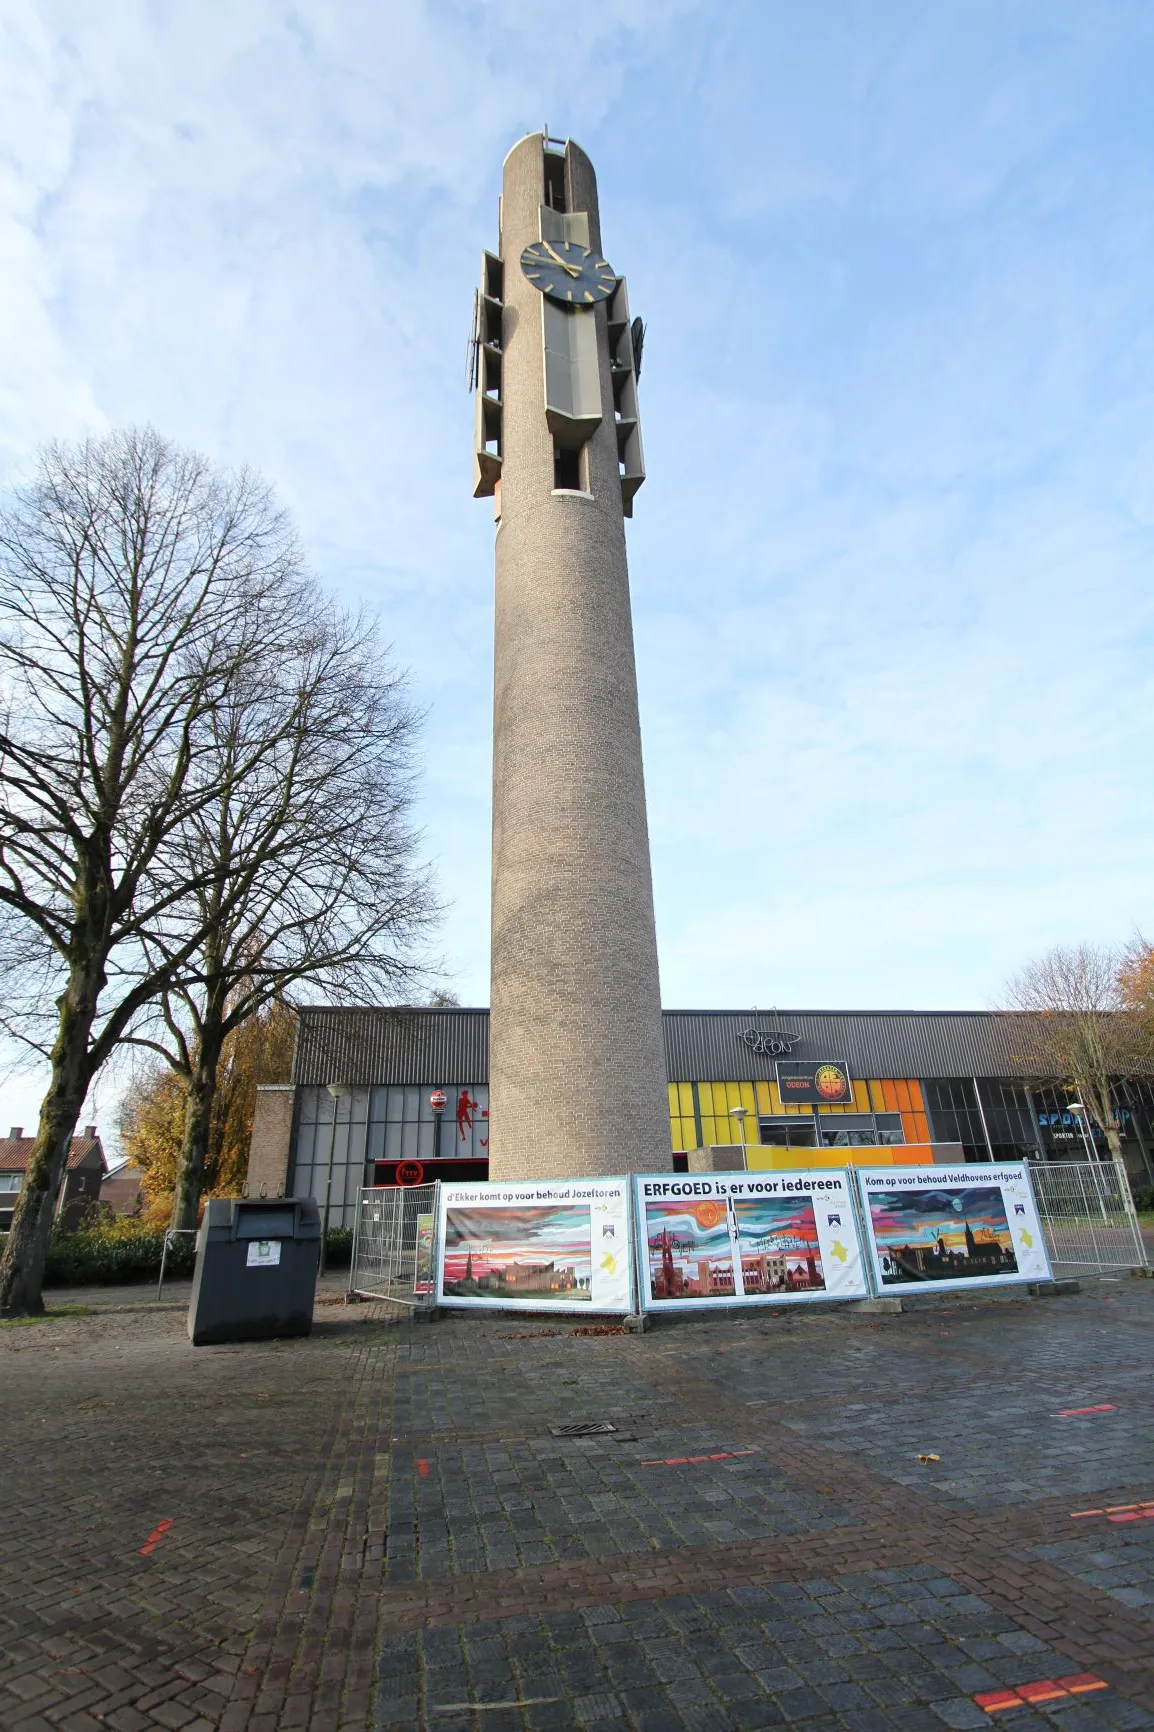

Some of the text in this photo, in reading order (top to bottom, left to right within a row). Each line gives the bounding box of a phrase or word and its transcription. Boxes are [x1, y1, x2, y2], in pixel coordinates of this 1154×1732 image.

[786, 1081, 810, 1089] ODEON
[865, 1172, 1022, 1187] Kom op voor behoud Veldhovens erfgoed
[644, 1178, 842, 1196] ERFGOED is er voor iedereen
[479, 1192, 501, 1201] komt
[502, 1193, 514, 1202] op
[515, 1192, 534, 1200] voor
[536, 1189, 570, 1199] behoud
[571, 1188, 621, 1199] Jozeftoren
